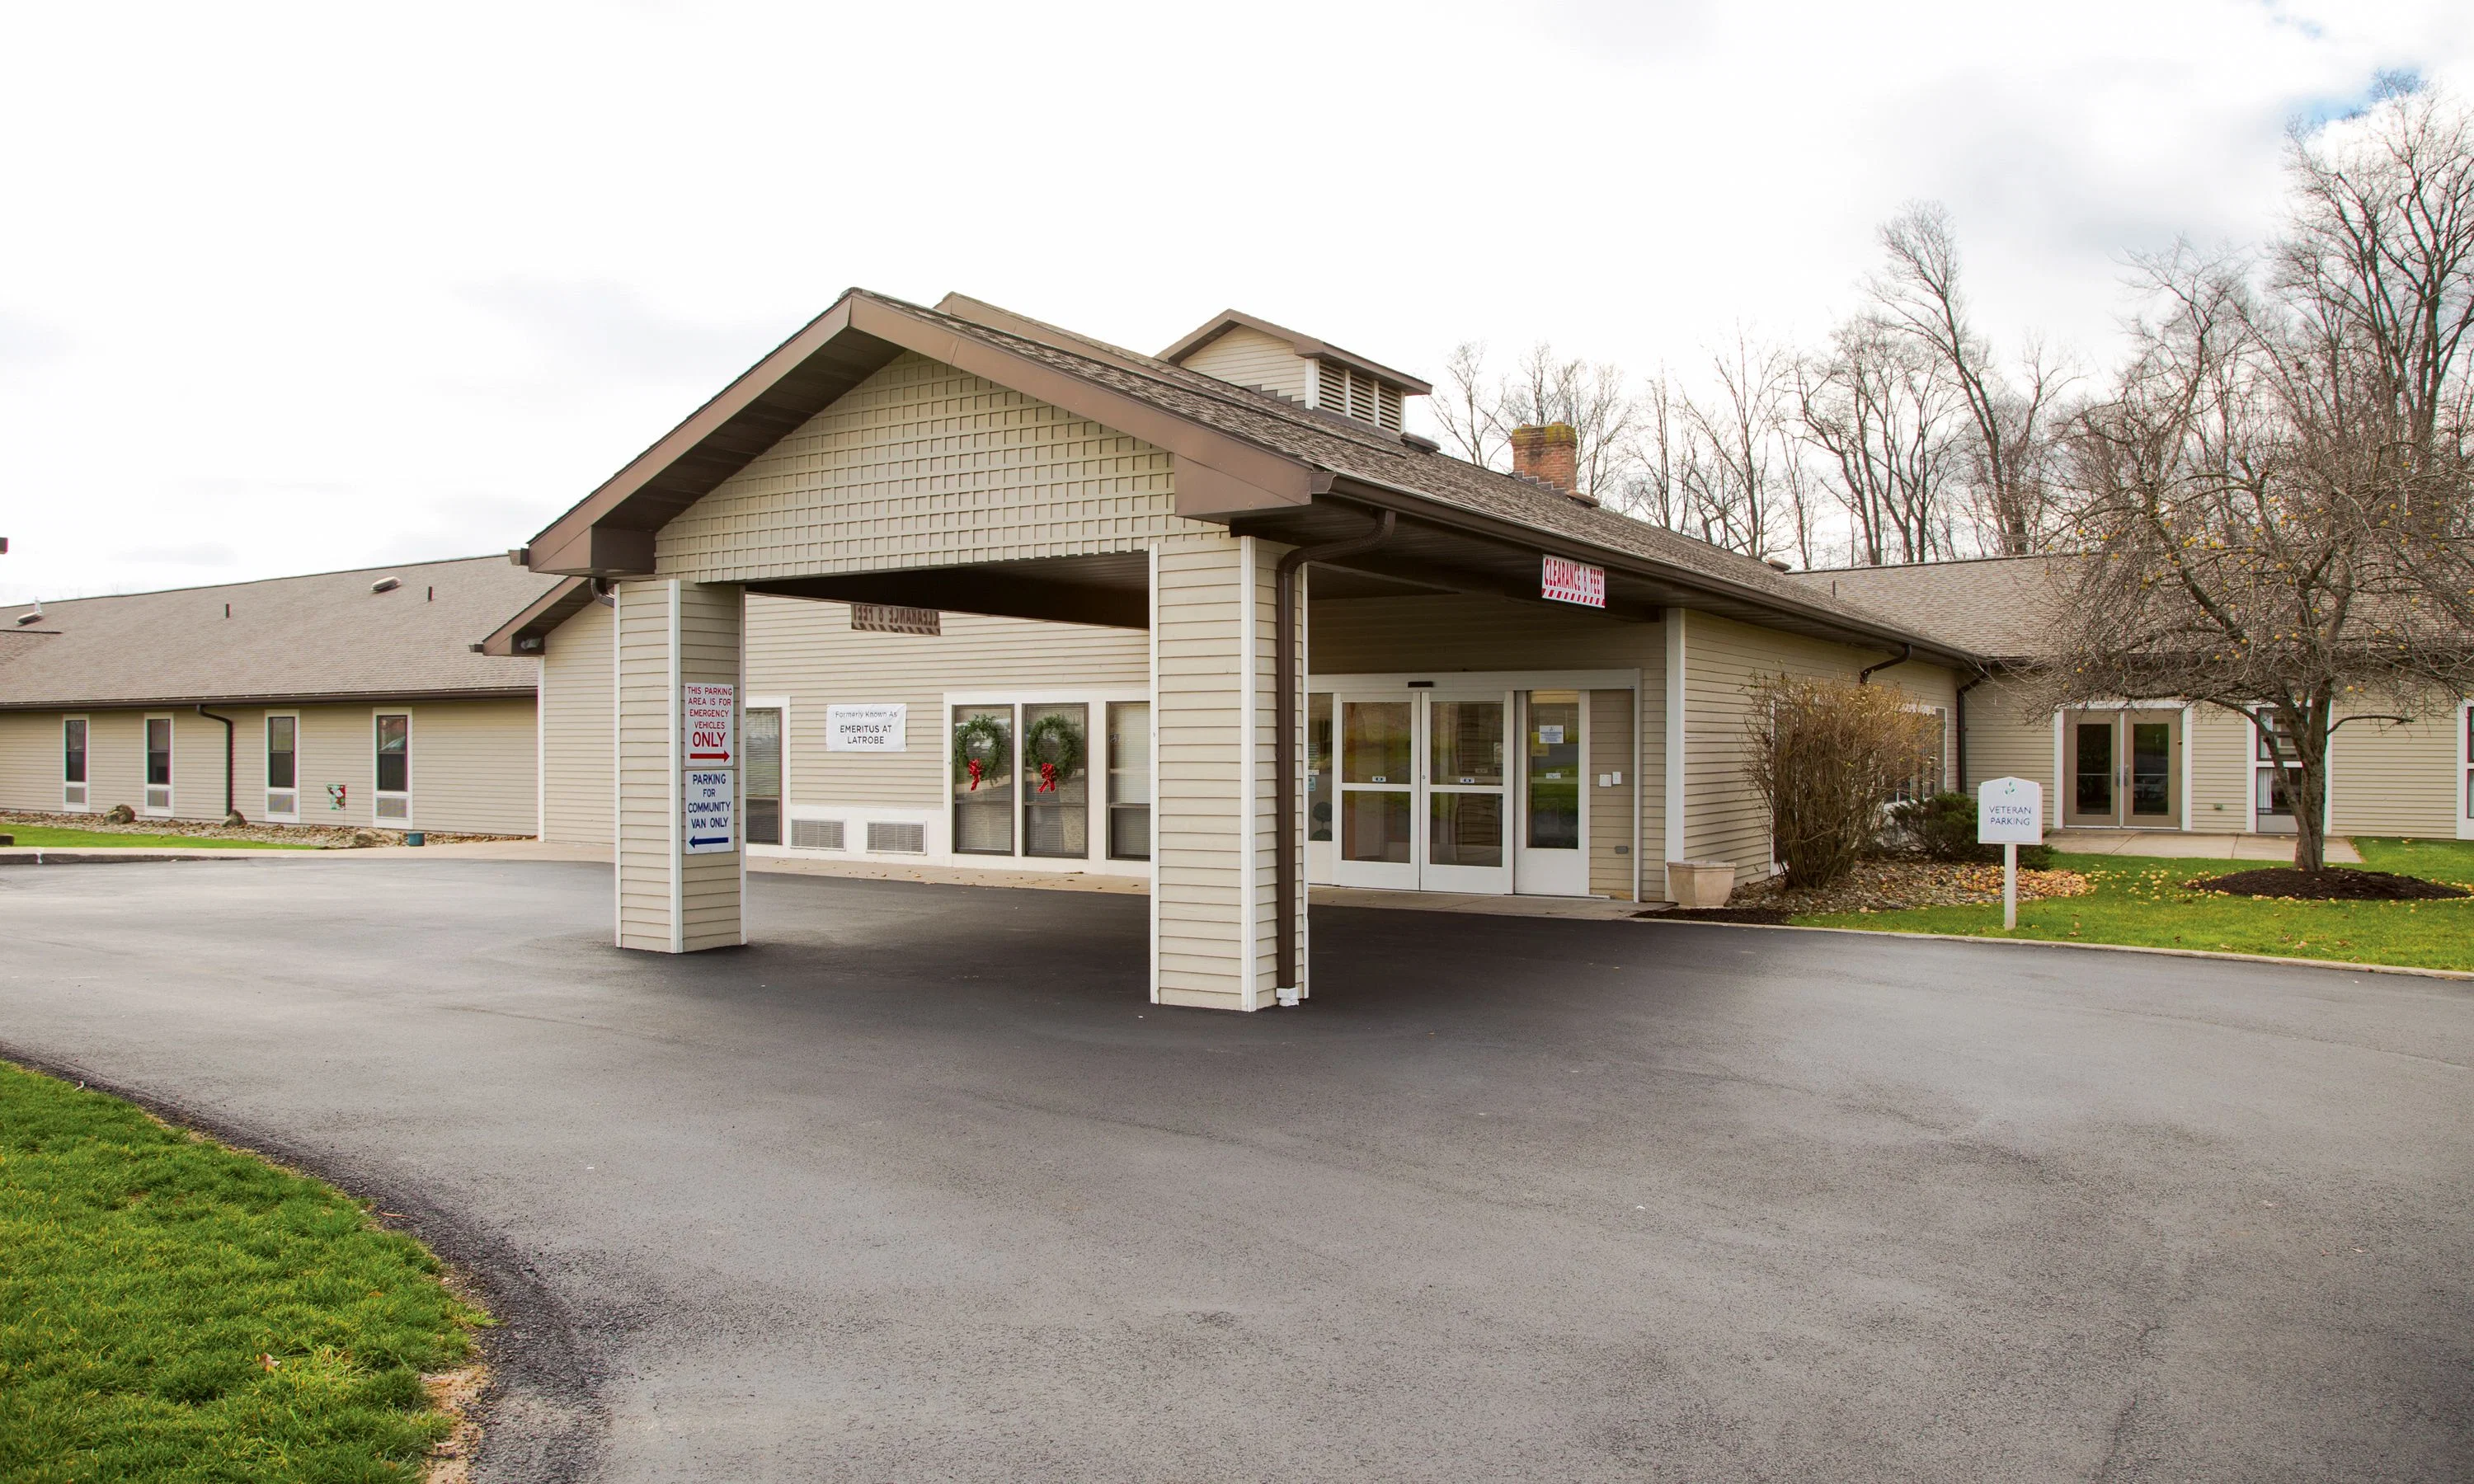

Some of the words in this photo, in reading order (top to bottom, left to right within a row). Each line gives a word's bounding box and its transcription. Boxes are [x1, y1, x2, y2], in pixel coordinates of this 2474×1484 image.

[1545, 558, 1580, 591] CLEARANCE
[1590, 568, 1603, 595] FEET
[687, 687, 701, 695] THIS
[704, 687, 732, 696] PARKING
[689, 709, 729, 717] EMERGENCY
[835, 711, 863, 719] Formerly
[694, 721, 725, 730] VEHICLES
[840, 725, 880, 733] EMERITUS
[882, 725, 892, 733] AT
[693, 731, 726, 747] ONLY
[693, 773, 726, 785] PARKING
[703, 788, 715, 797] FOR
[688, 801, 731, 813] COMMUNITY
[1989, 805, 2031, 814] VETERAN
[691, 818, 706, 829] VAN
[710, 816, 728, 828] ONLY
[1990, 817, 2030, 826] PARKING
